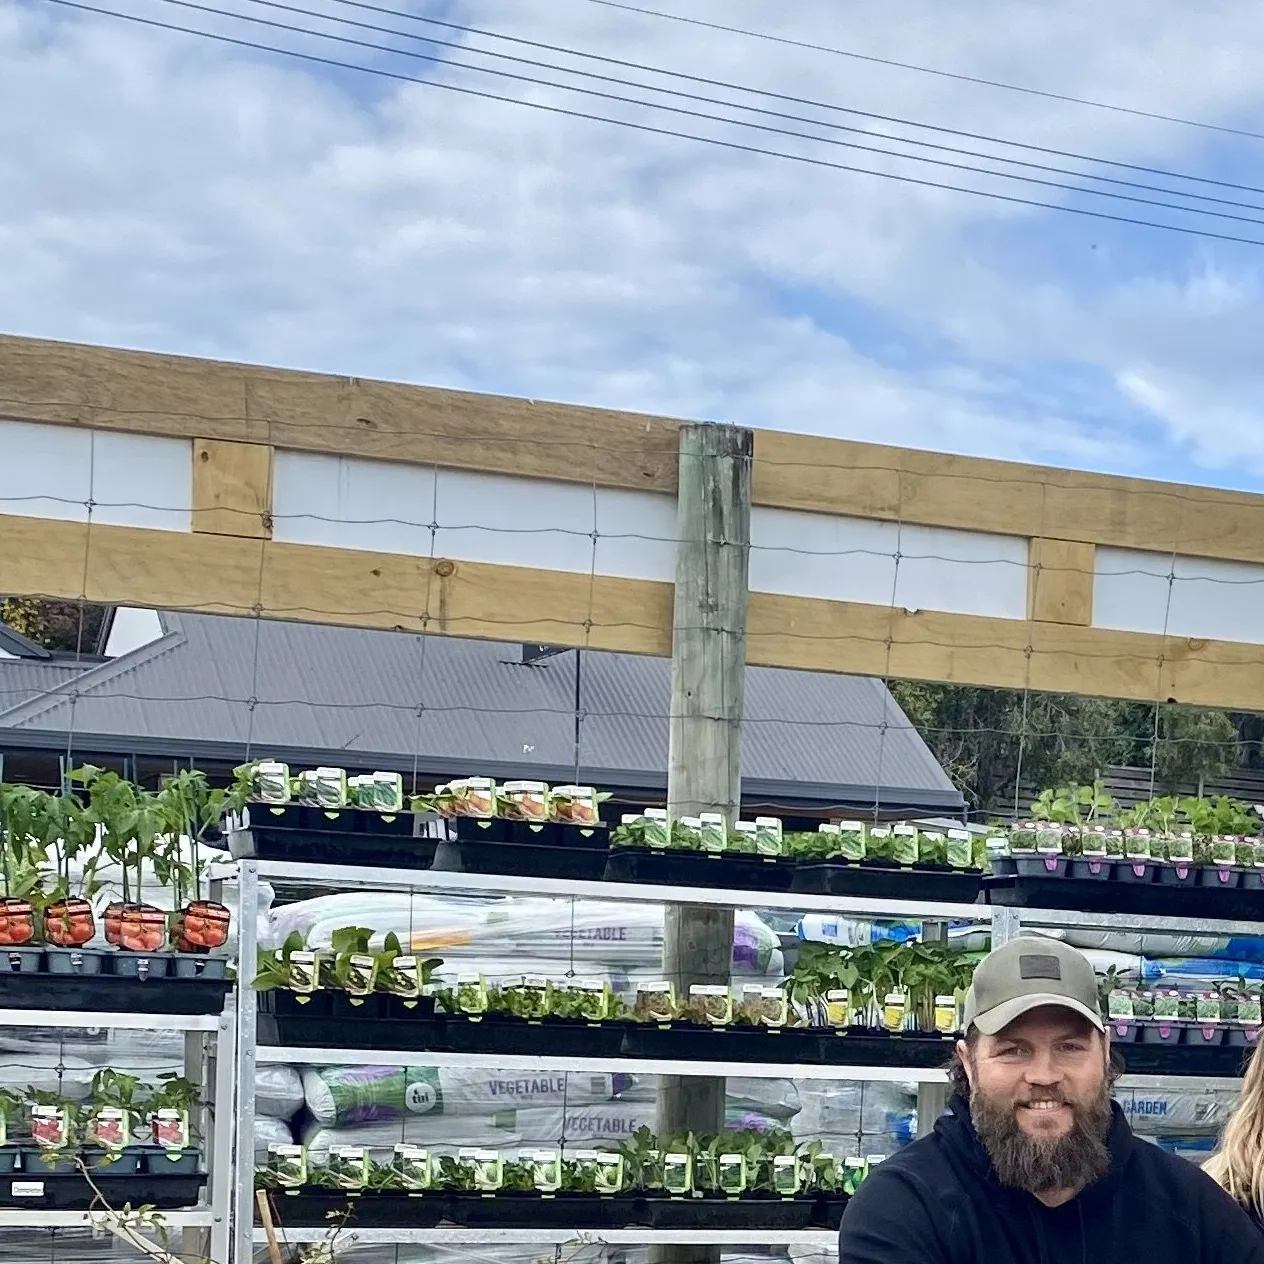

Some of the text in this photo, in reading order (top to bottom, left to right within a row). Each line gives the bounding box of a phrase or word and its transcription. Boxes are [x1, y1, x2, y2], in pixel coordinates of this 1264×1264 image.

[488, 1077, 565, 1096] VEGETABLE
[1123, 1101, 1168, 1116] GARDEN
[565, 1117, 636, 1133] VEGETABLE
